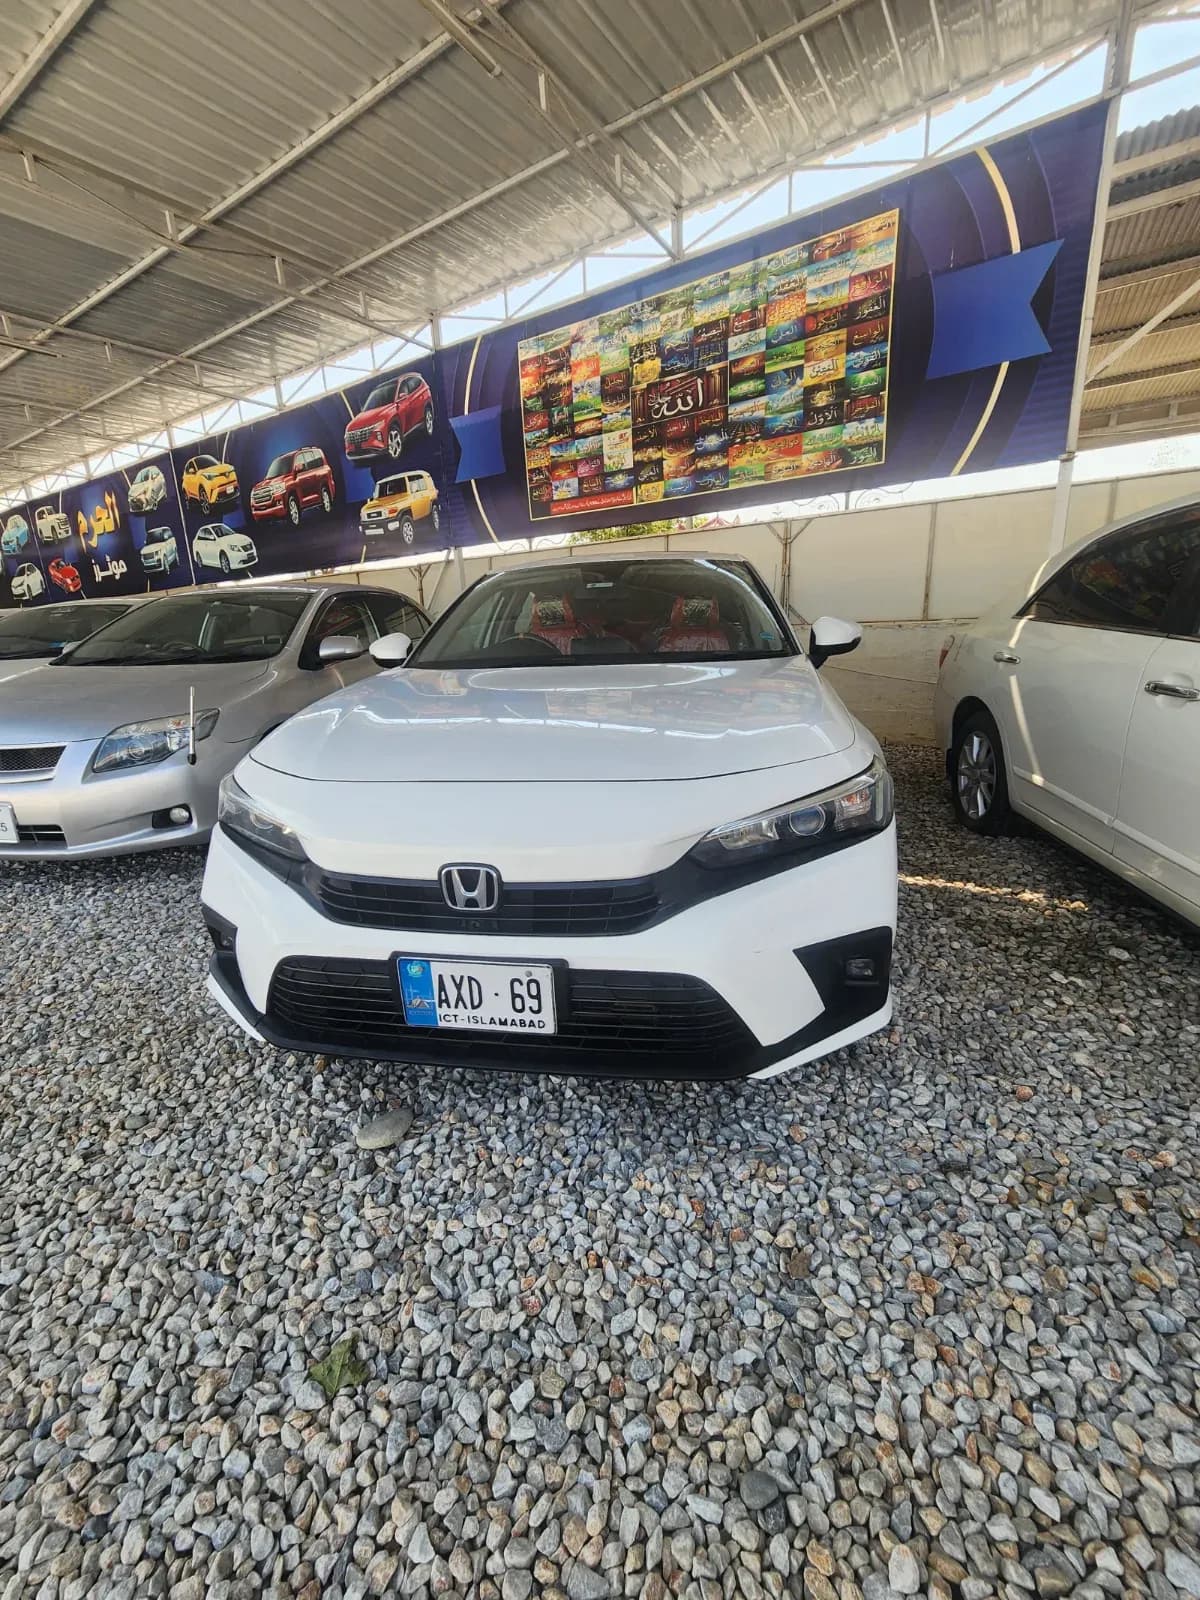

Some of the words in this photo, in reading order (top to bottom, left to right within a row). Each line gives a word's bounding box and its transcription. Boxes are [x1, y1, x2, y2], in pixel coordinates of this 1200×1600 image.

[652, 376, 704, 418] الله
[437, 973, 483, 1010] AXD
[509, 977, 543, 1015] 69
[438, 1012, 547, 1030] ICT-ISLAMABAD
